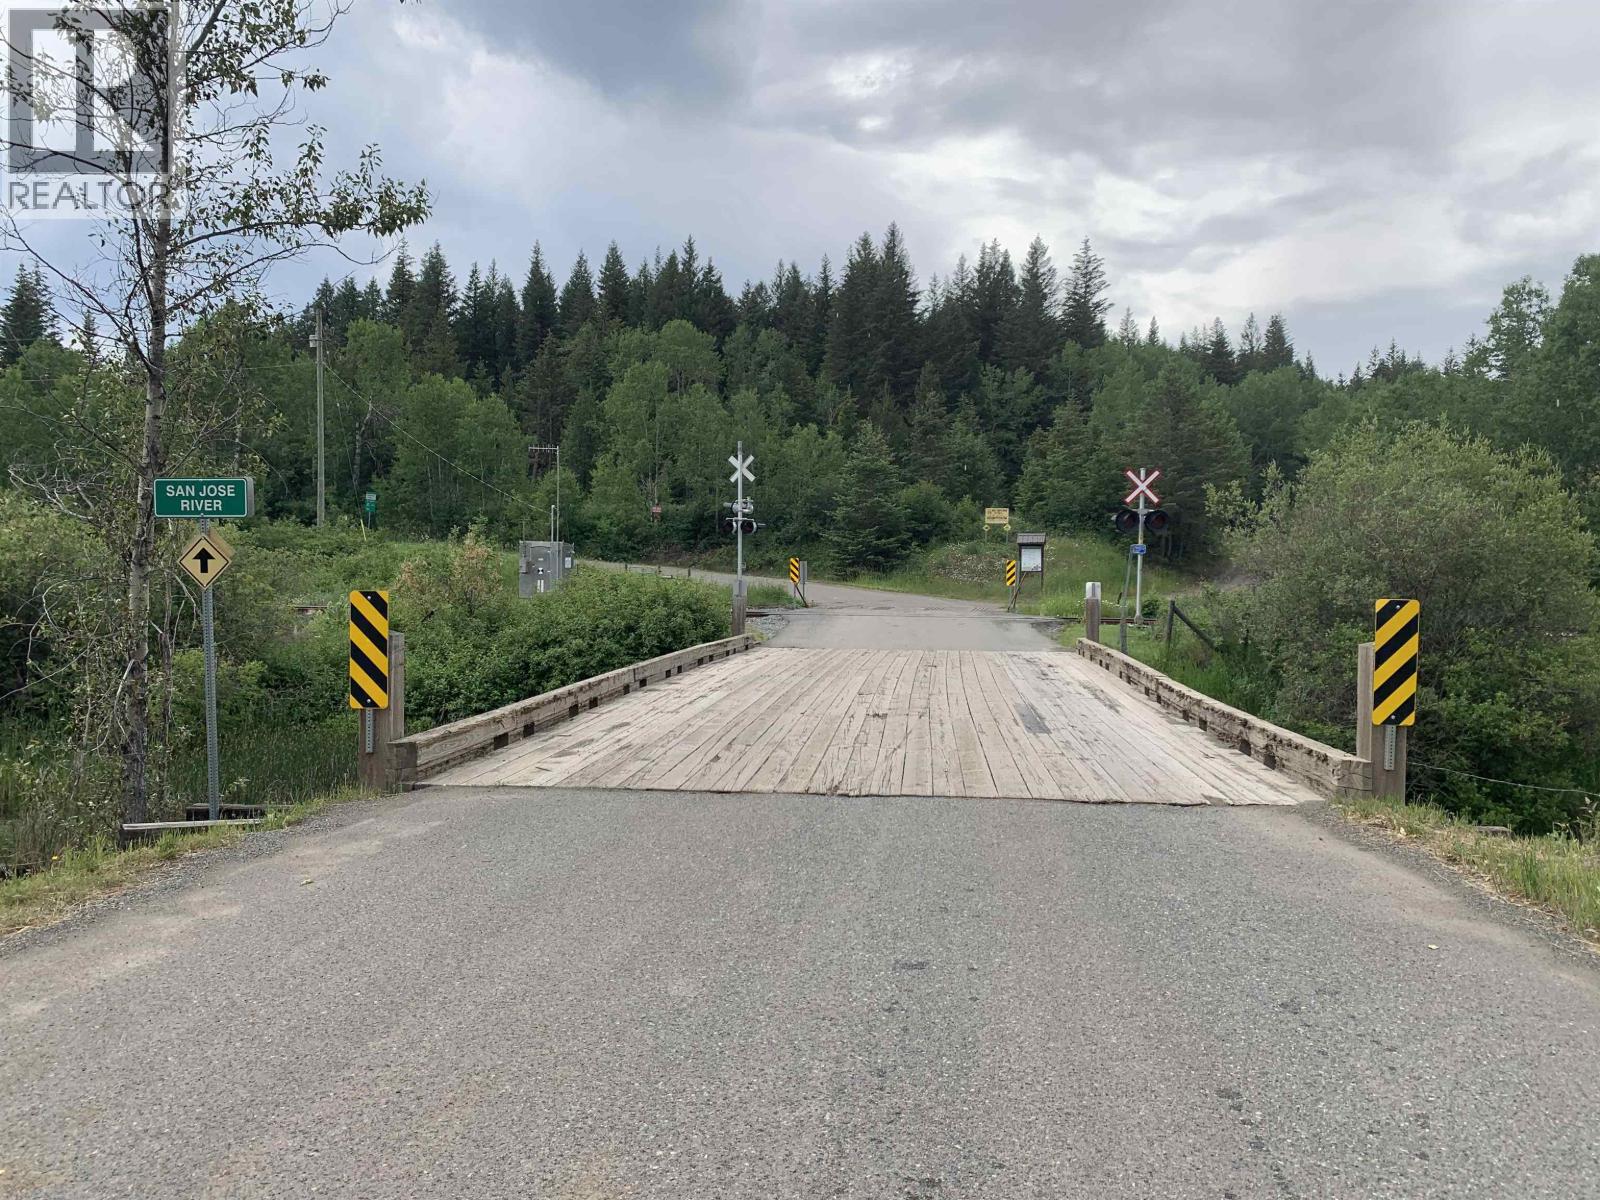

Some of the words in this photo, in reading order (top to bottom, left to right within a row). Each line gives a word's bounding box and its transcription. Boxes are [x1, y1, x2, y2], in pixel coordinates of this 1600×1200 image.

[166, 485, 195, 497] SAN
[199, 485, 236, 497] JOSE
[180, 499, 223, 511] RIVER
